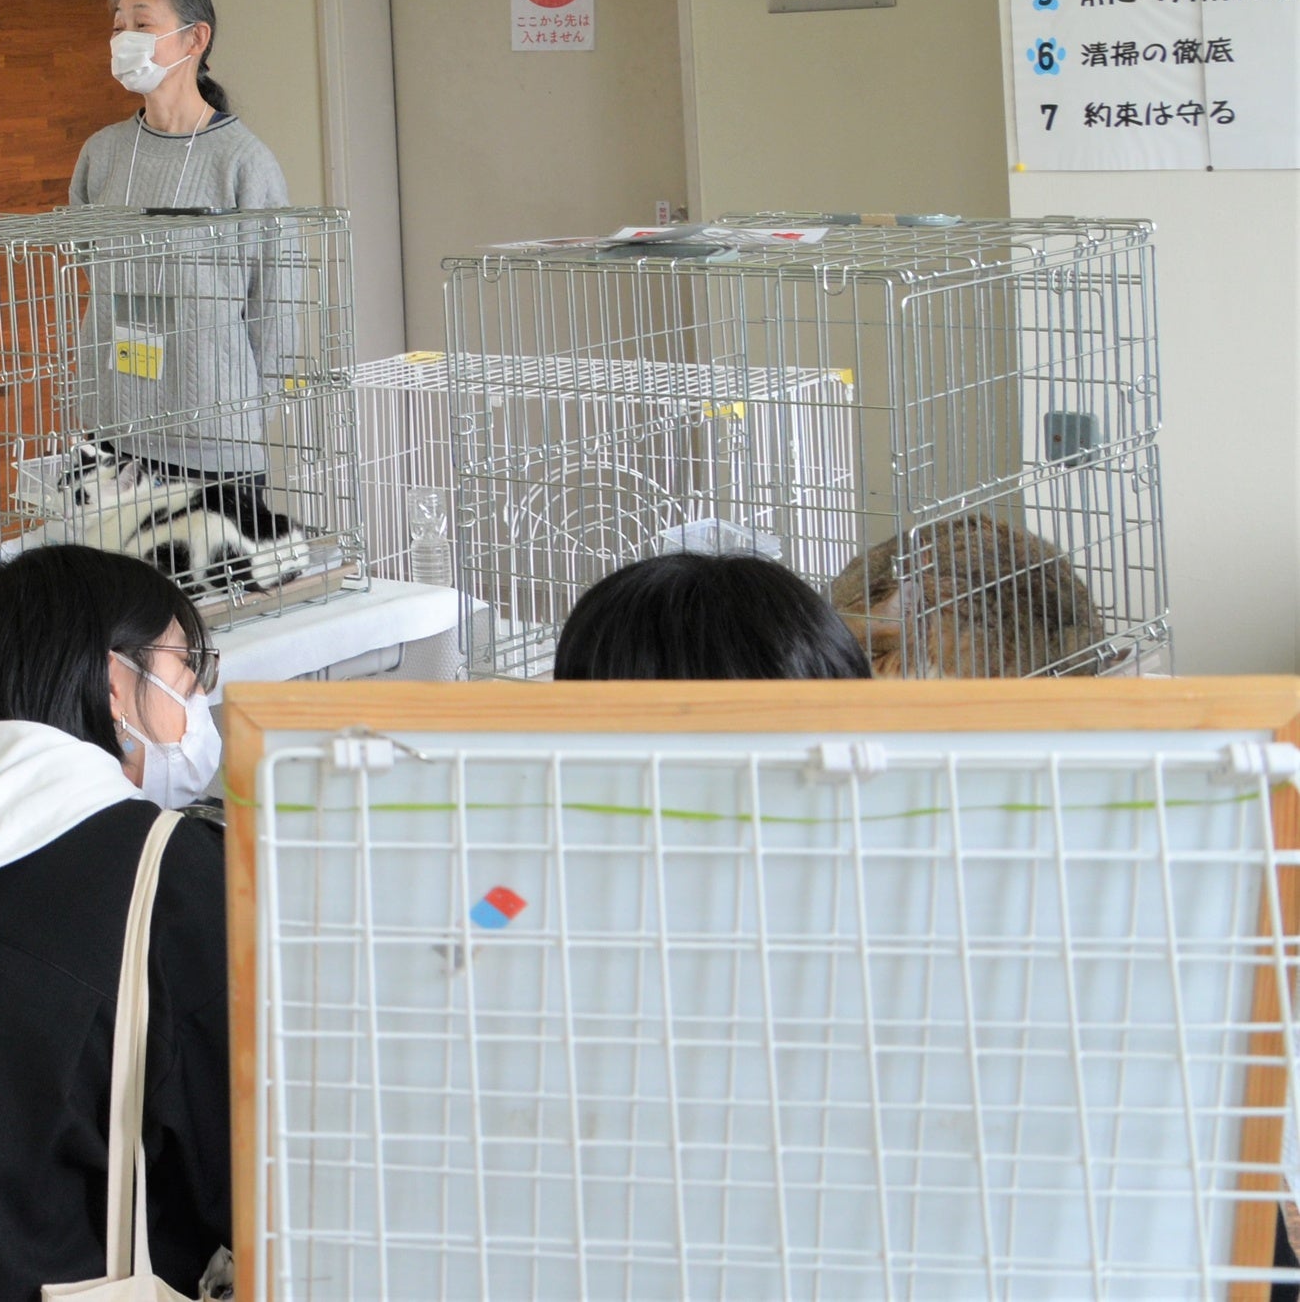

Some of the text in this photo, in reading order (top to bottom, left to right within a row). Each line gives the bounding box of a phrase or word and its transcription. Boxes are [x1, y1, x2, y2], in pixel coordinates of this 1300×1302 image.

[517, 13, 590, 28] ここから先は
[521, 30, 585, 44] 入れません
[1037, 37, 1235, 71] 6 清掃の徹底
[1040, 100, 1236, 131] 7 約束は守る
